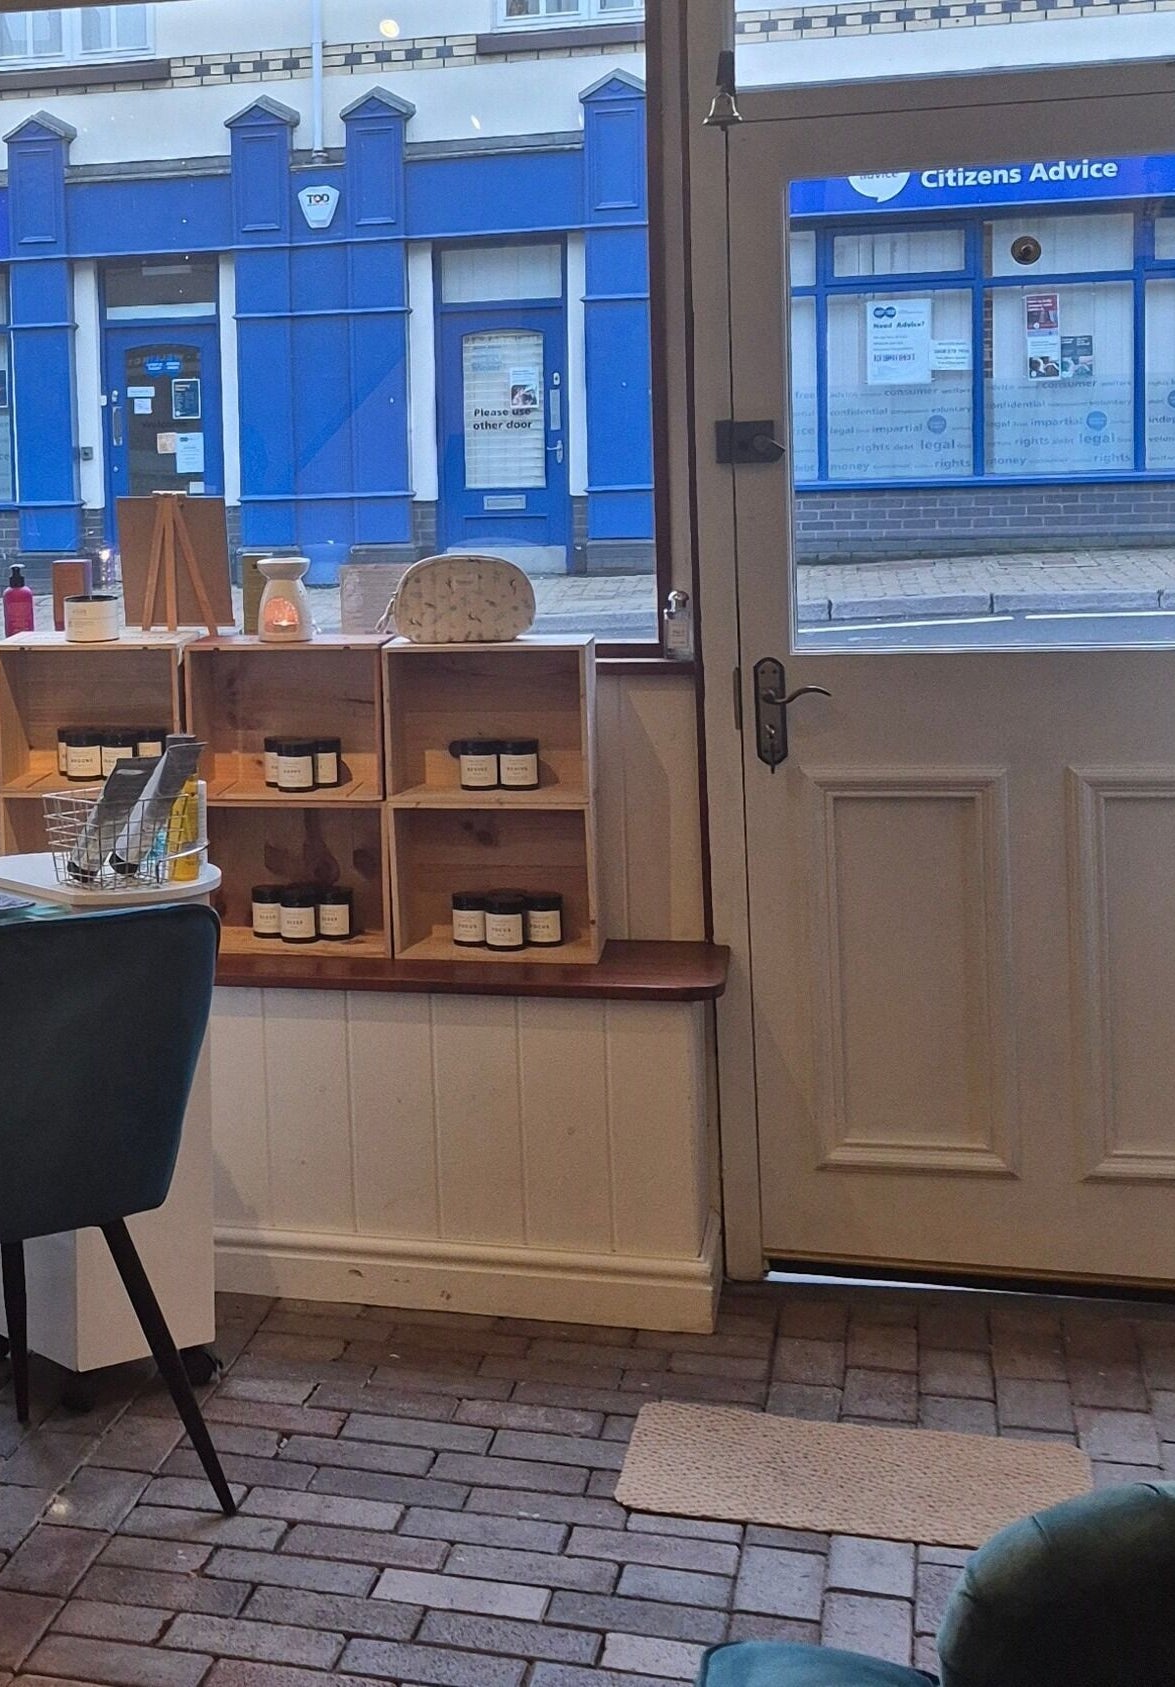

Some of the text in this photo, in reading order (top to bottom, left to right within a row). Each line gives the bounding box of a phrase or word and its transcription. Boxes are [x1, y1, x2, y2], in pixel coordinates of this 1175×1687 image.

[921, 159, 1119, 188] Citizens Advice
[884, 387, 938, 397] consumer
[474, 408, 532, 417] Please use
[830, 407, 888, 417] confidential
[473, 420, 533, 431] other door
[872, 423, 924, 434] impartial
[1014, 437, 1050, 447] rights
[1079, 432, 1115, 446] legal
[856, 443, 891, 454] rights
[920, 439, 956, 452] legal
[1094, 453, 1132, 464] rights
[830, 463, 870, 473] money
[934, 459, 972, 470] rights
